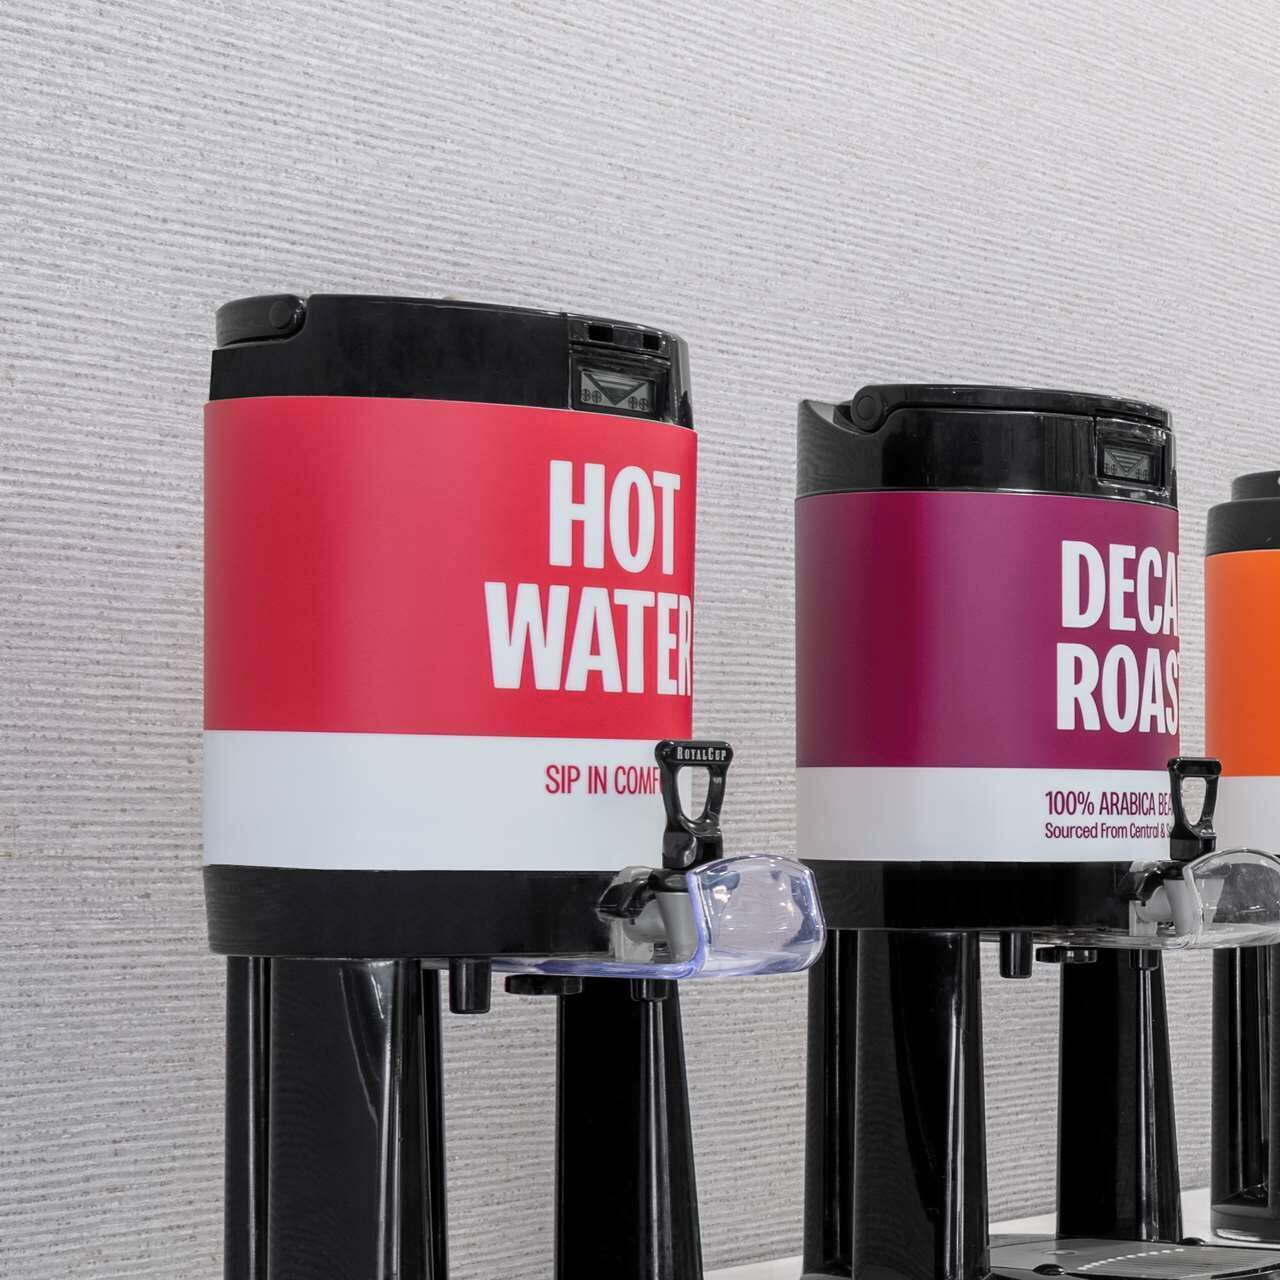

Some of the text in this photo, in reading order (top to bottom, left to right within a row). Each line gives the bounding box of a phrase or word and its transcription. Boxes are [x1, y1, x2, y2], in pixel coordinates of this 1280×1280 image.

[549, 460, 681, 575] HOT
[1062, 540, 1180, 637] DECA
[484, 581, 692, 697] WATER
[1057, 642, 1180, 735] ROAS
[545, 764, 663, 794] SIP IN COMF
[1045, 790, 1173, 816] 100% ARABICA BEA
[1045, 822, 1098, 839] Sourced
[1101, 822, 1127, 839] From
[1129, 822, 1158, 839] Central
